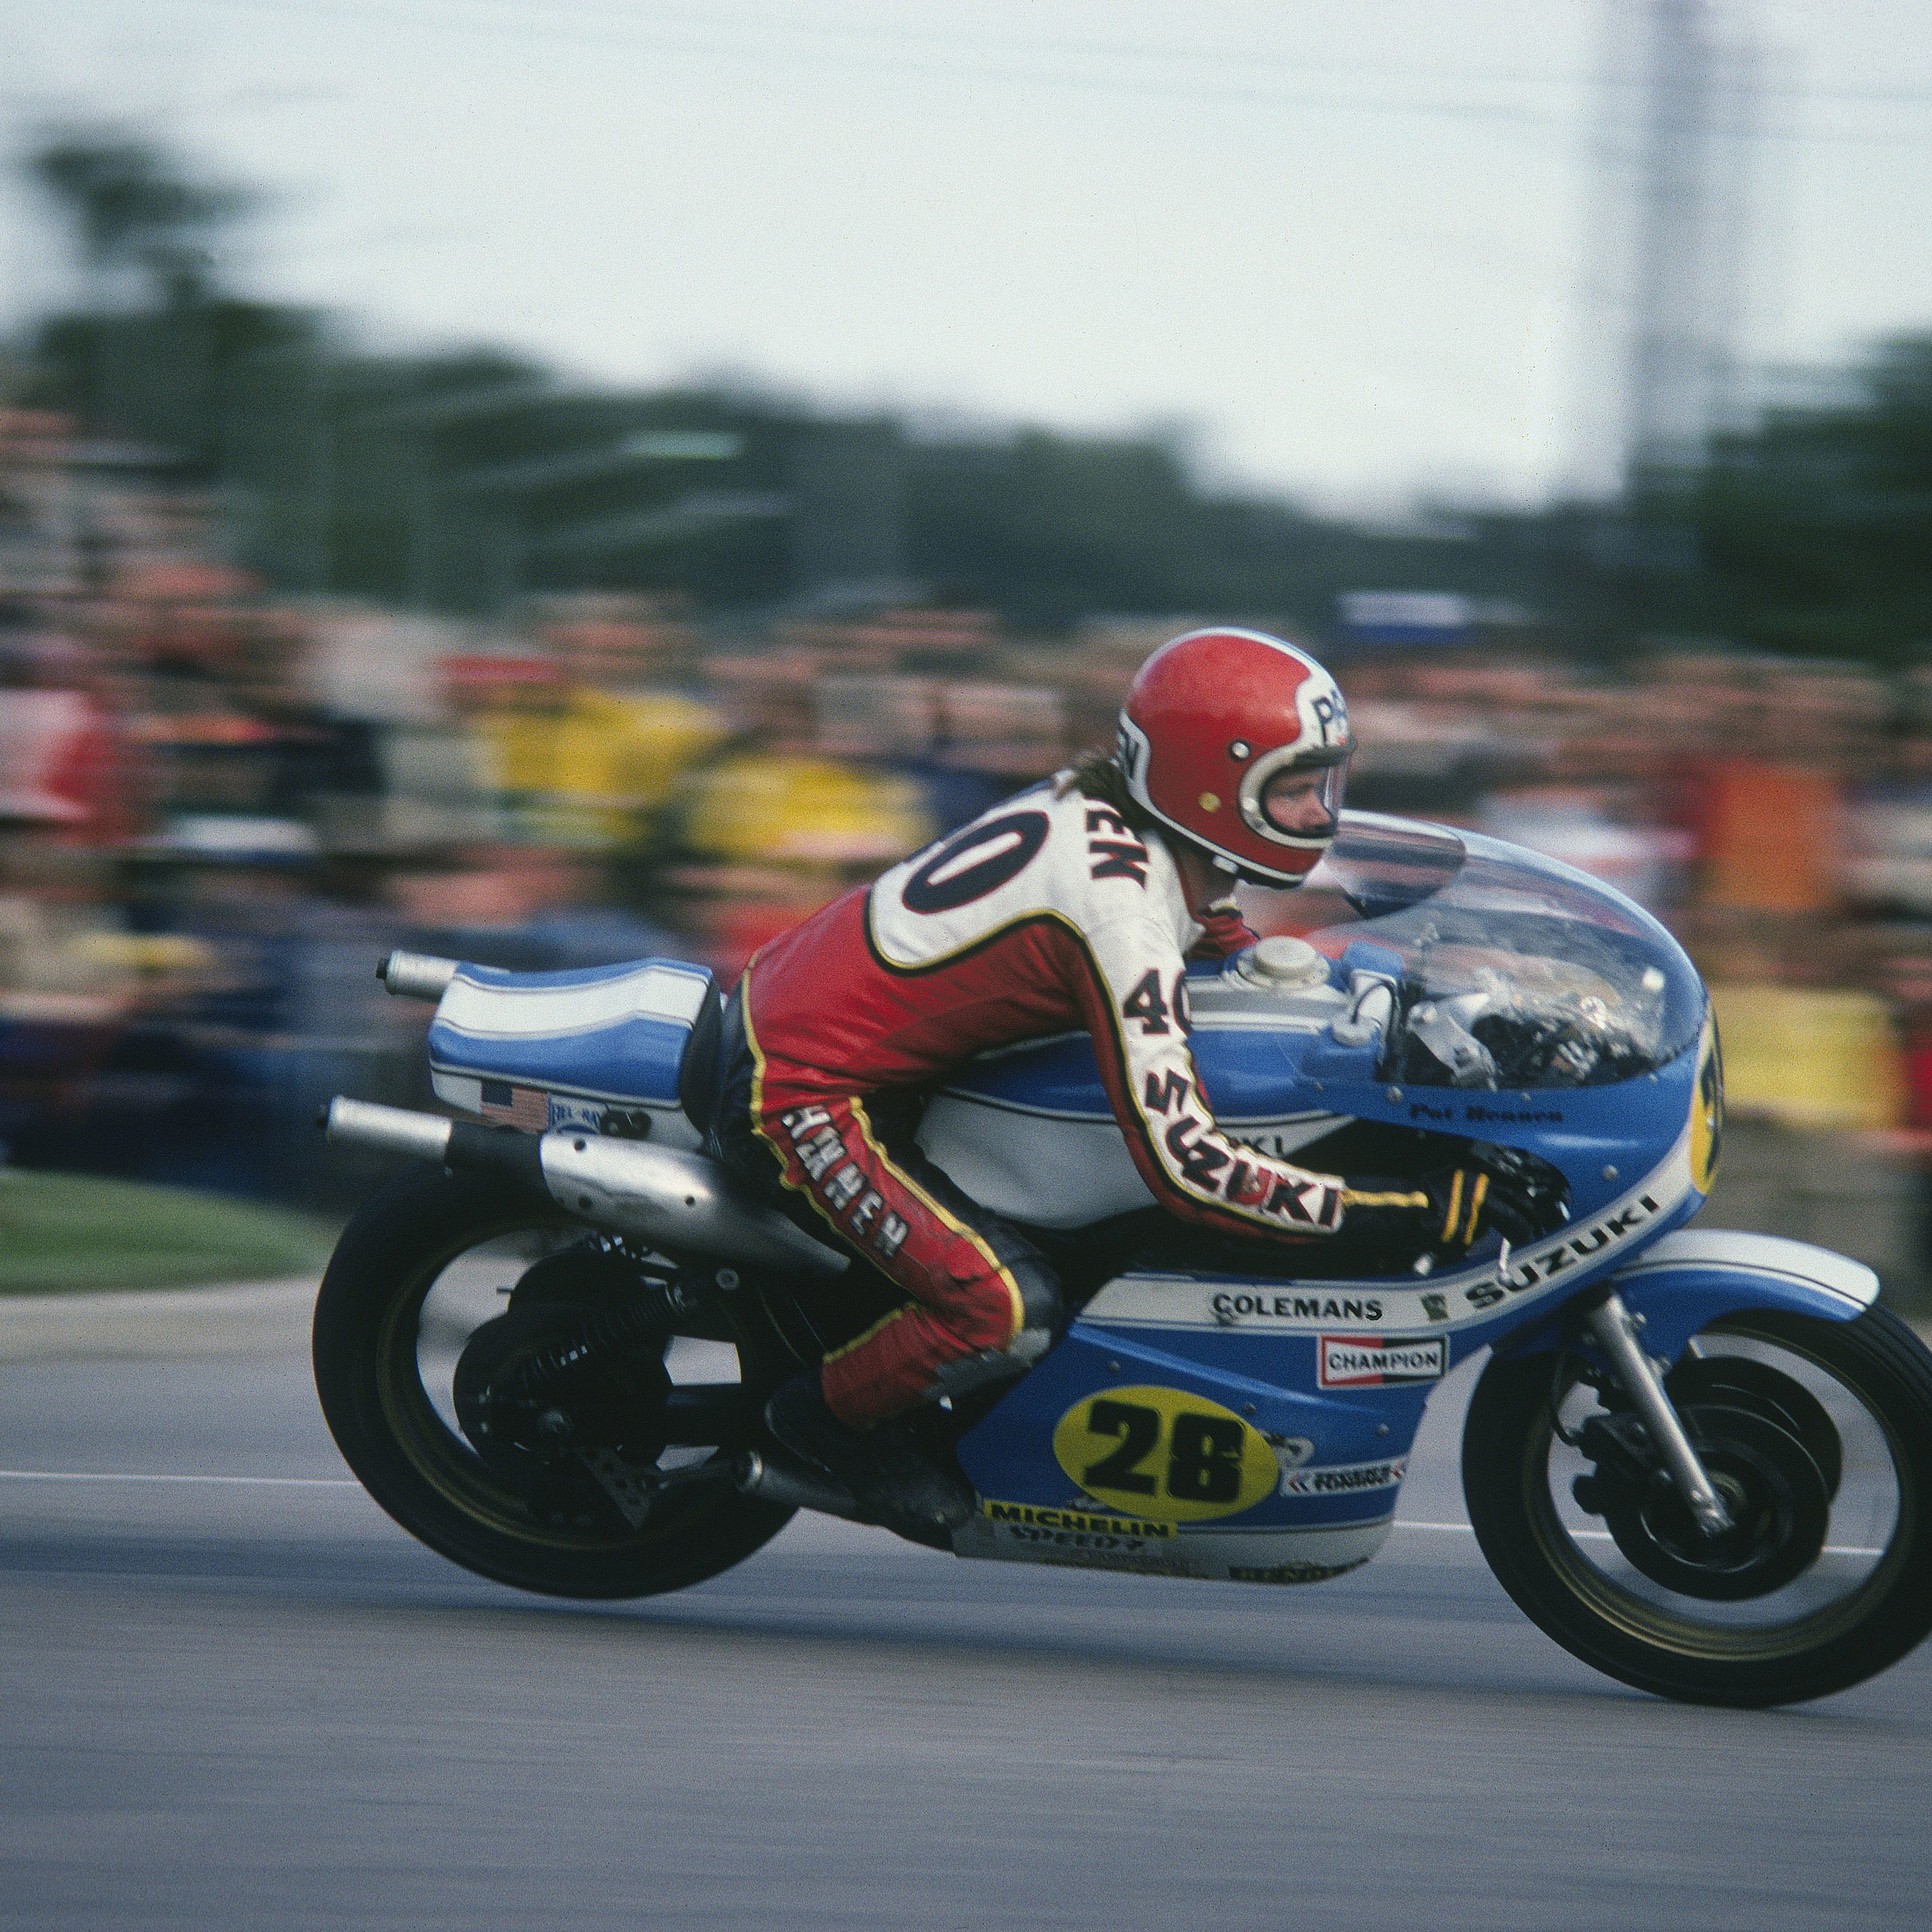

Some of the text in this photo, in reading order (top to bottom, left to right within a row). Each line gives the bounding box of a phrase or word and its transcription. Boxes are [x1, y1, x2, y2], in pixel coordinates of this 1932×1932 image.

[1145, 1068, 1341, 1229] SUZUKI
[1465, 1195, 1660, 1309] SUZUKI
[1212, 1293, 1383, 1321] COLEMANS
[1329, 1352, 1438, 1371] CHAMPION
[1082, 1398, 1244, 1503] 28
[991, 1503, 1170, 1537] MICHELIN
